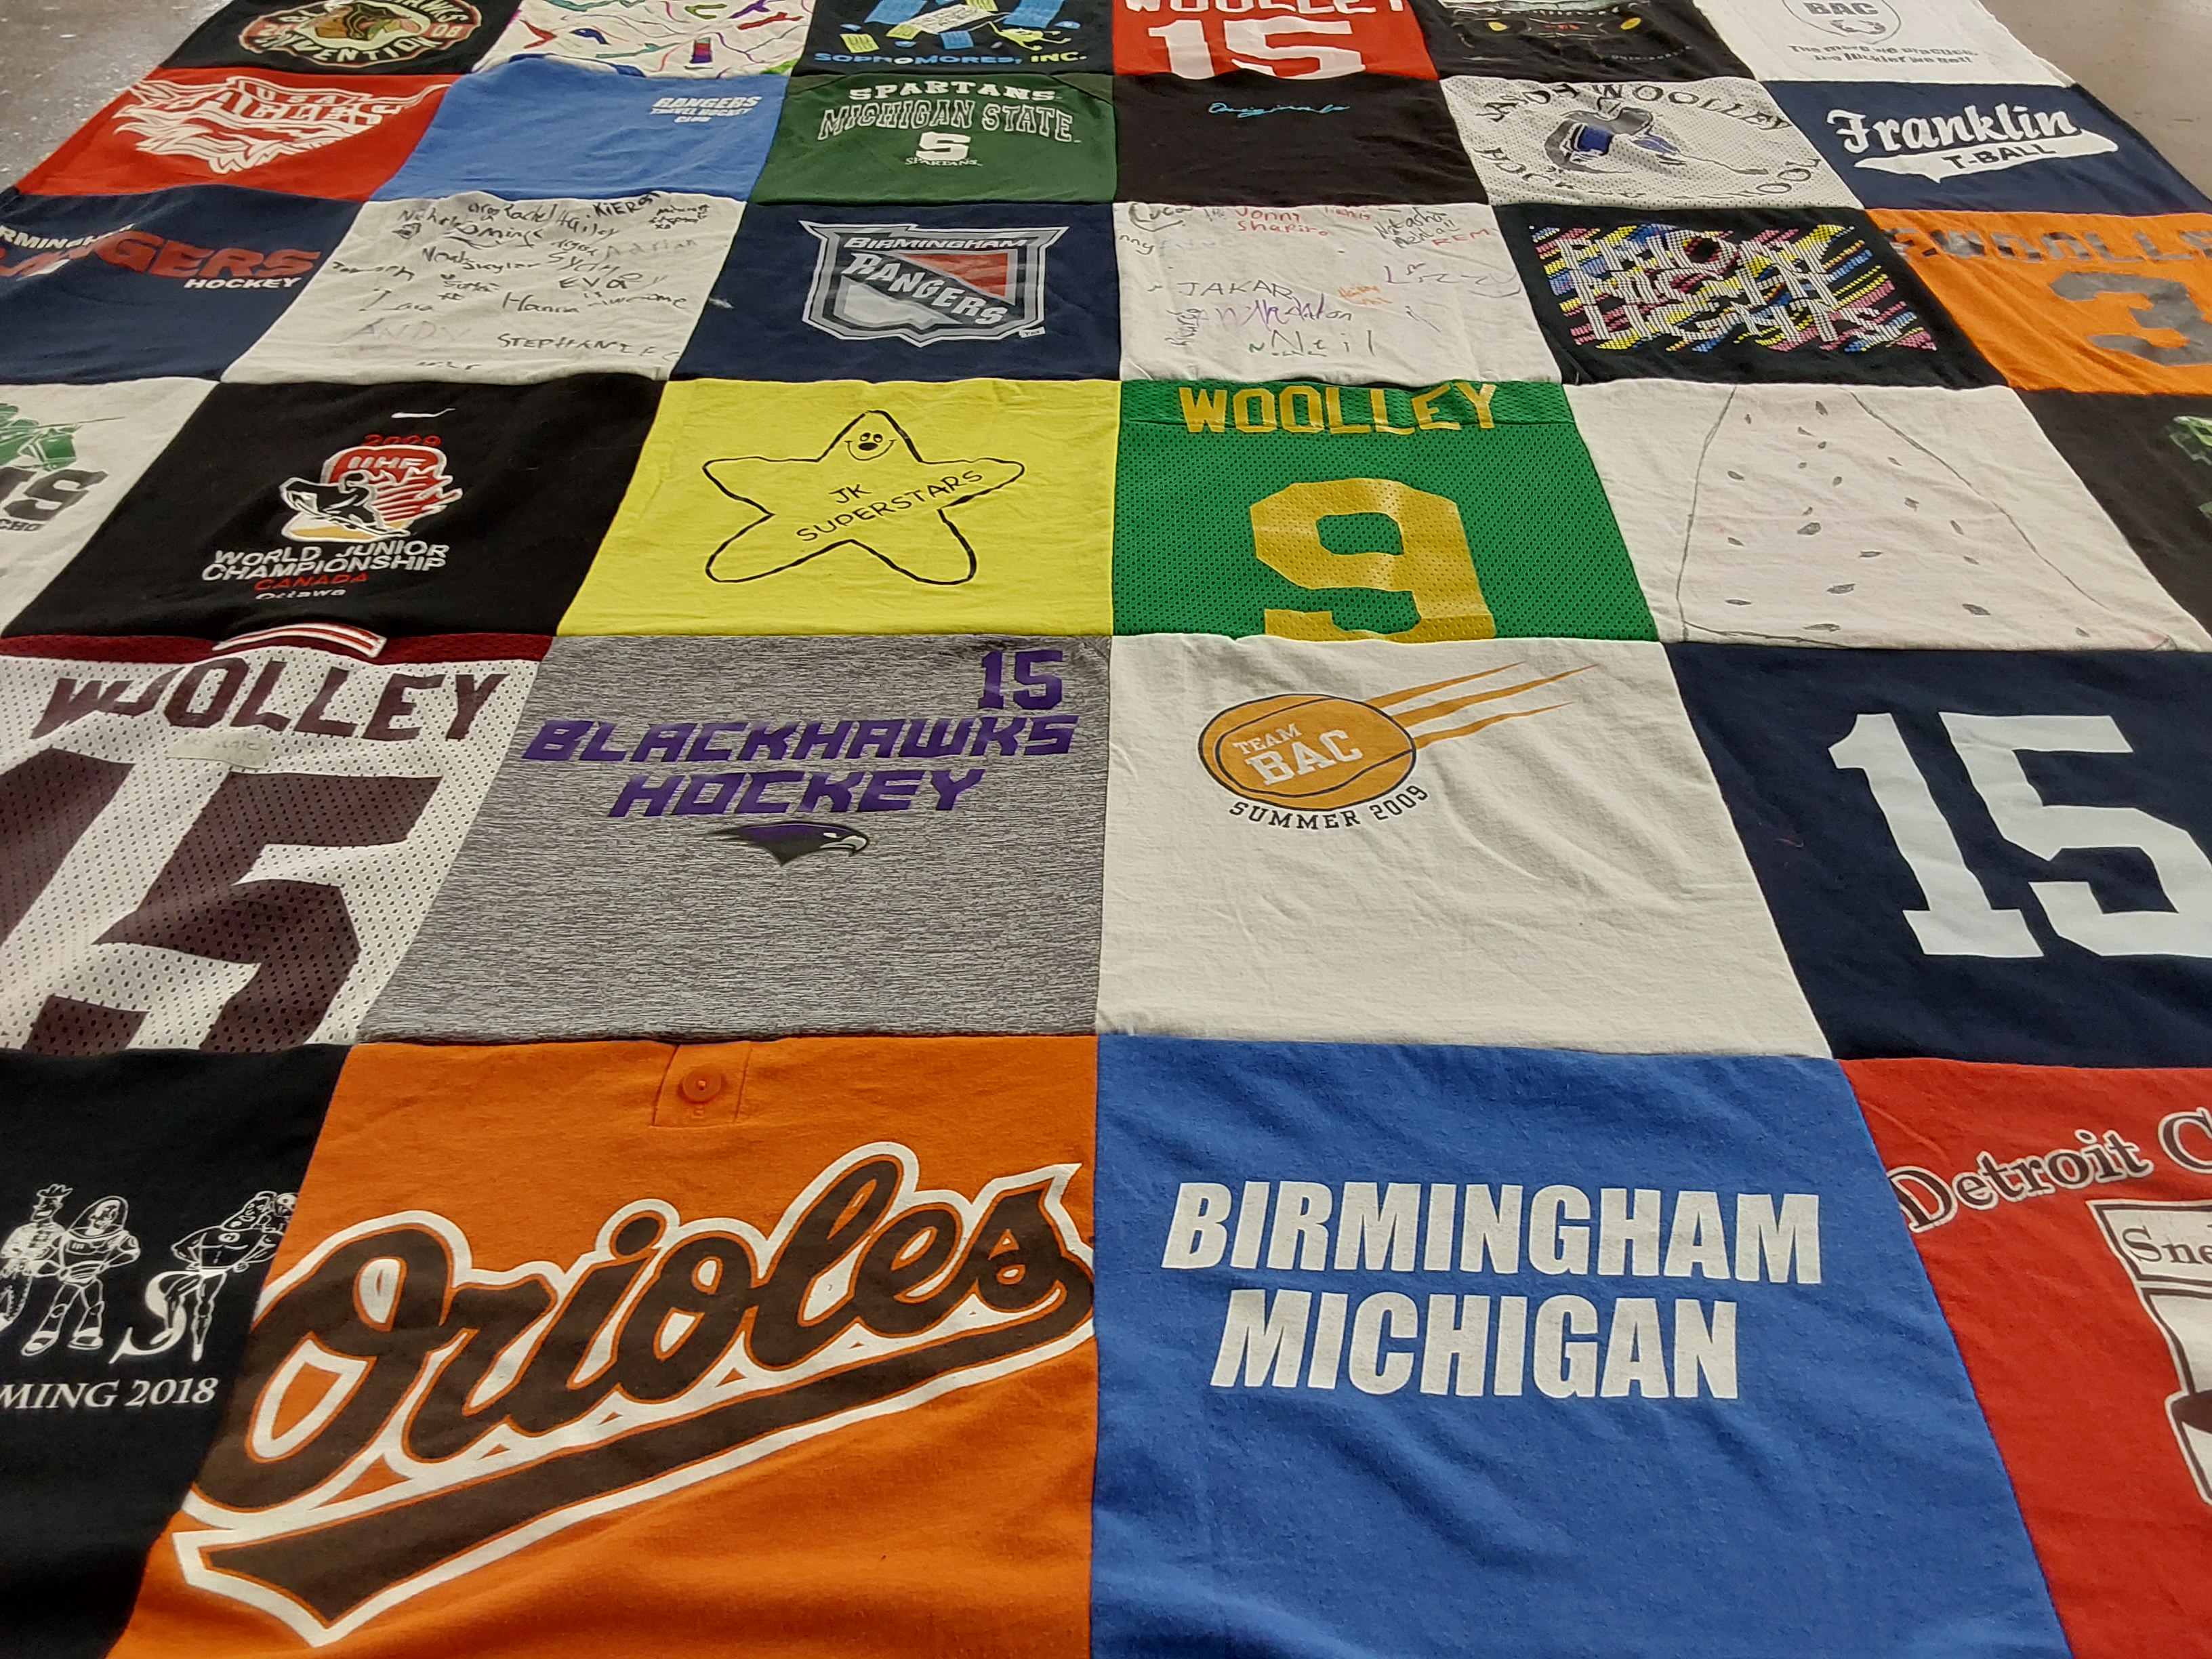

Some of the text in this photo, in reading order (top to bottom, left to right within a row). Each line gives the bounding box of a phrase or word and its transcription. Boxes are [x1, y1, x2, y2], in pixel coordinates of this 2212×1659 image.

[1803, 2, 1879, 15] BAC
[432, 24, 459, 38] 08
[1148, 16, 1366, 80] 15
[1030, 52, 1087, 63] INC.
[652, 96, 763, 109] RANGERS
[848, 81, 1057, 101] SPARTANS
[817, 100, 1074, 142] MICHIGAN STATE
[1827, 103, 2078, 153] Franklin
[1943, 142, 2057, 170] T-BALL
[844, 237, 1027, 249] BIRMINGHAM
[183, 276, 303, 290] HOCKEY
[840, 253, 1008, 325] RANGERS
[1179, 381, 1497, 435] WOOLLEY
[363, 434, 442, 447] 2009
[347, 456, 427, 470] IIHF
[796, 470, 983, 541] SUPERSTARS
[828, 483, 872, 504] JK
[202, 555, 447, 582] CHAMPIONSHIP
[214, 541, 450, 567] WORLD JUNIOR
[1250, 478, 1497, 644] 9
[253, 572, 369, 592] CANADA
[255, 588, 346, 600] Ottawa
[977, 649, 1065, 710] 15
[521, 714, 1080, 763] BLACKHAWKS
[1232, 722, 1303, 756] TEAM
[1244, 729, 1364, 787] BAC
[607, 768, 986, 818] HOCKEY
[1229, 784, 1429, 830] SUMMER 2009
[1828, 712, 2212, 958] 15
[1888, 1128, 2154, 1233] Detroit
[1160, 1181, 1823, 1284] BIRMINGHAM
[192, 1142, 1097, 1515] Orioles
[1210, 1289, 1739, 1399] MICHIGAN
[125, 1377, 220, 1408] 2018
